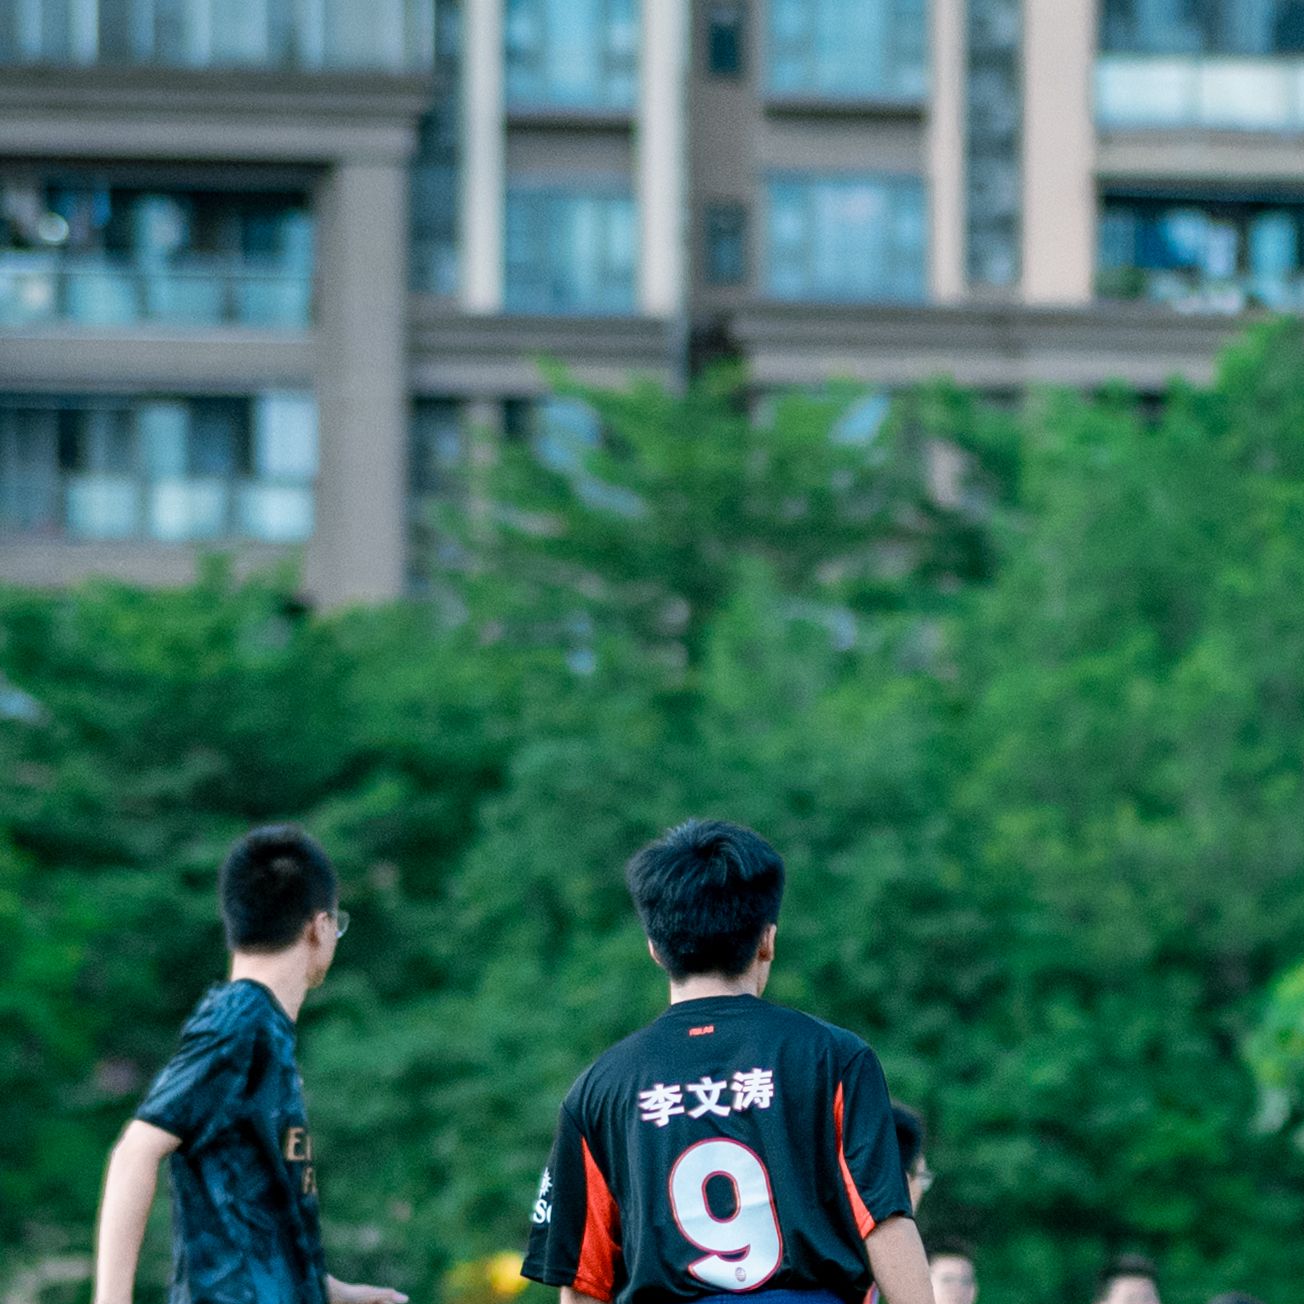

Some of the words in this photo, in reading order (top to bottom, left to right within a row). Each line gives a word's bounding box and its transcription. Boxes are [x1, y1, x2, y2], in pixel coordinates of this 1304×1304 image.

[638, 1067, 774, 1128] 李文涛
[668, 1137, 784, 1293] 9
